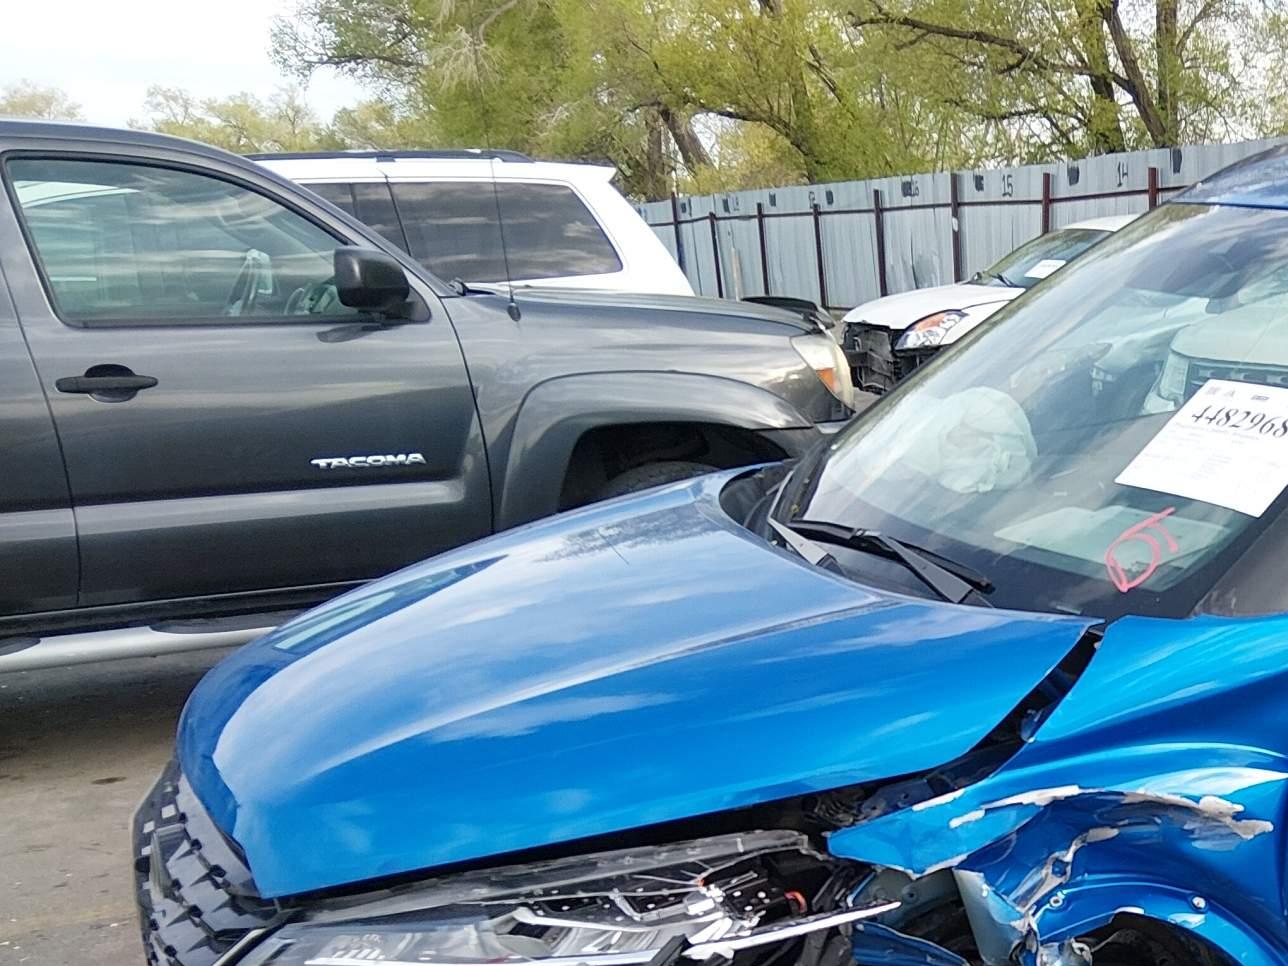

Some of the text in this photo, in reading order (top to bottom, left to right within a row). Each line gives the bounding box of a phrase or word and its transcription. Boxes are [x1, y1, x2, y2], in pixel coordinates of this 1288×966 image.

[1001, 174, 1014, 197] 15
[1116, 161, 1129, 188] 14
[310, 452, 427, 469] TACOMA
